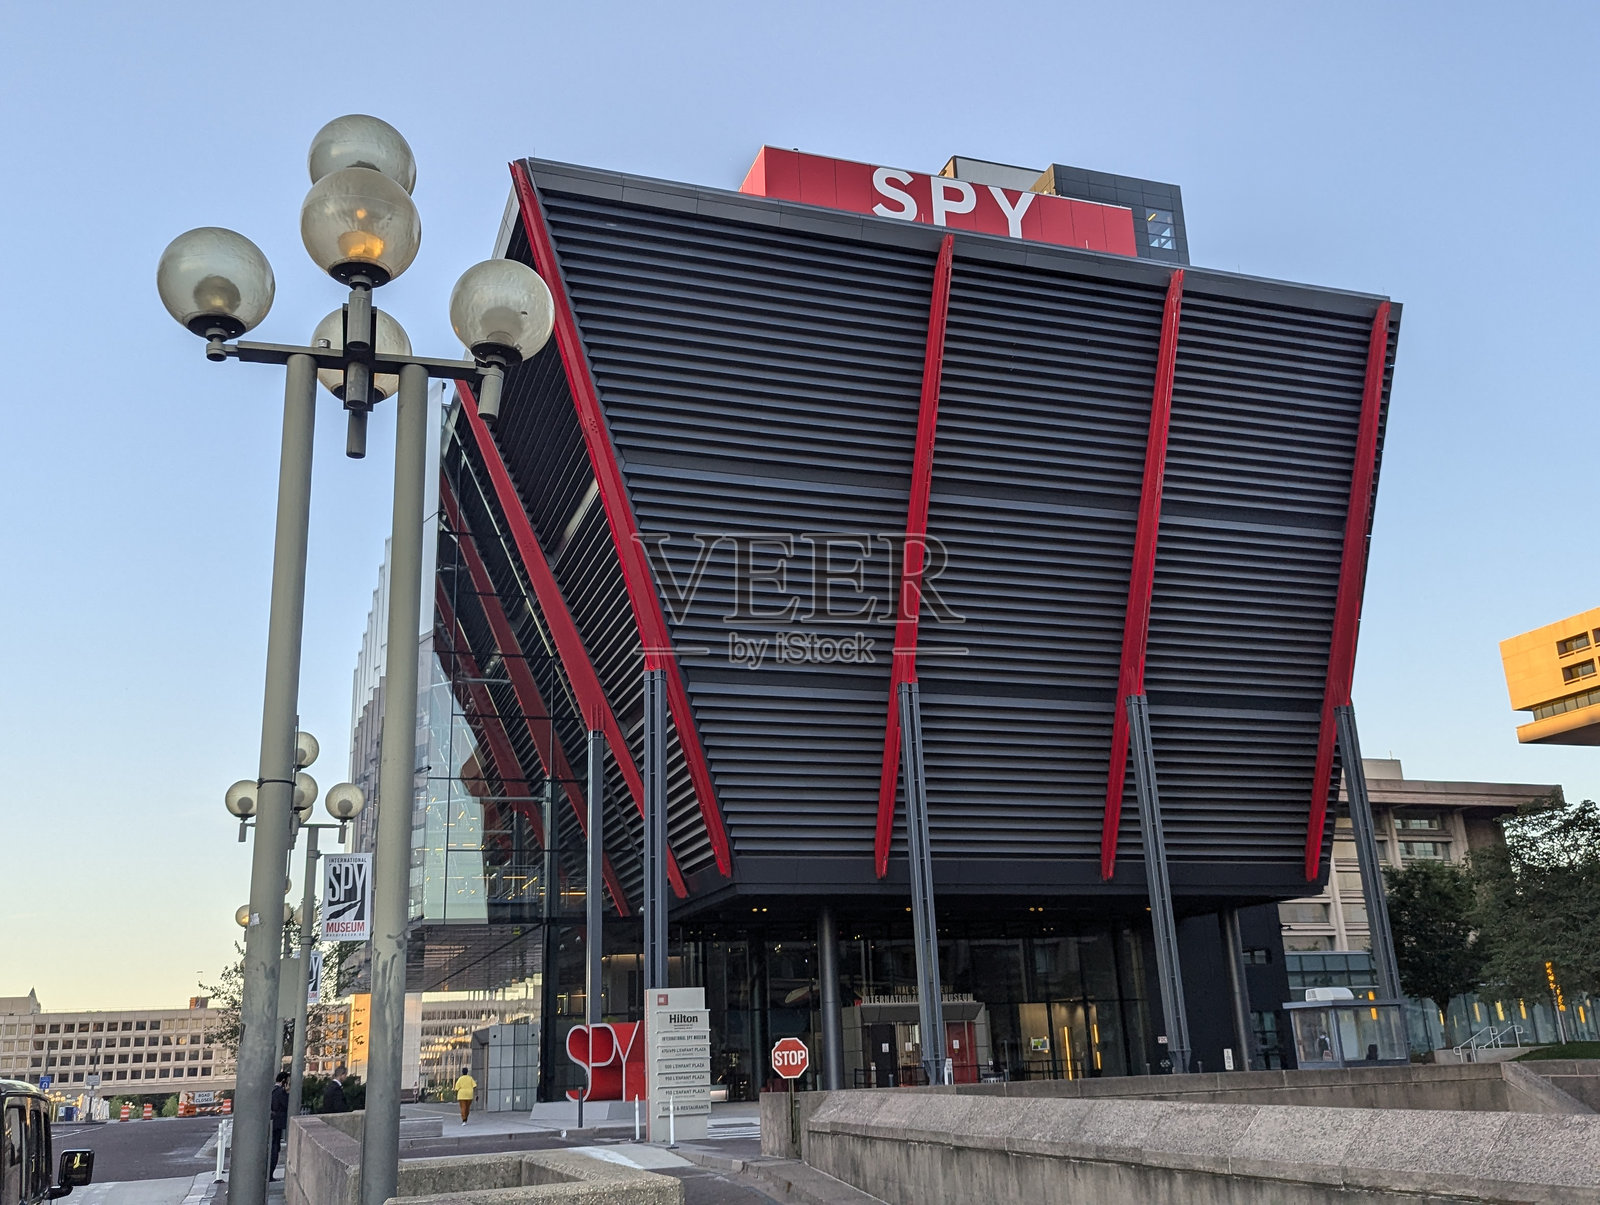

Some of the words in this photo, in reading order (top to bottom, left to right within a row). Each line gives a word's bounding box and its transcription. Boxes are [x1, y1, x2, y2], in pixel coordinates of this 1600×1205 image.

[872, 166, 1036, 239] SPY
[328, 864, 367, 902] SPY
[326, 921, 365, 933] MUSEUM
[942, 993, 974, 1002] MUSEUM
[669, 1014, 699, 1024] Hilton
[565, 1020, 641, 1103] SPY
[774, 1050, 806, 1067] STOP
